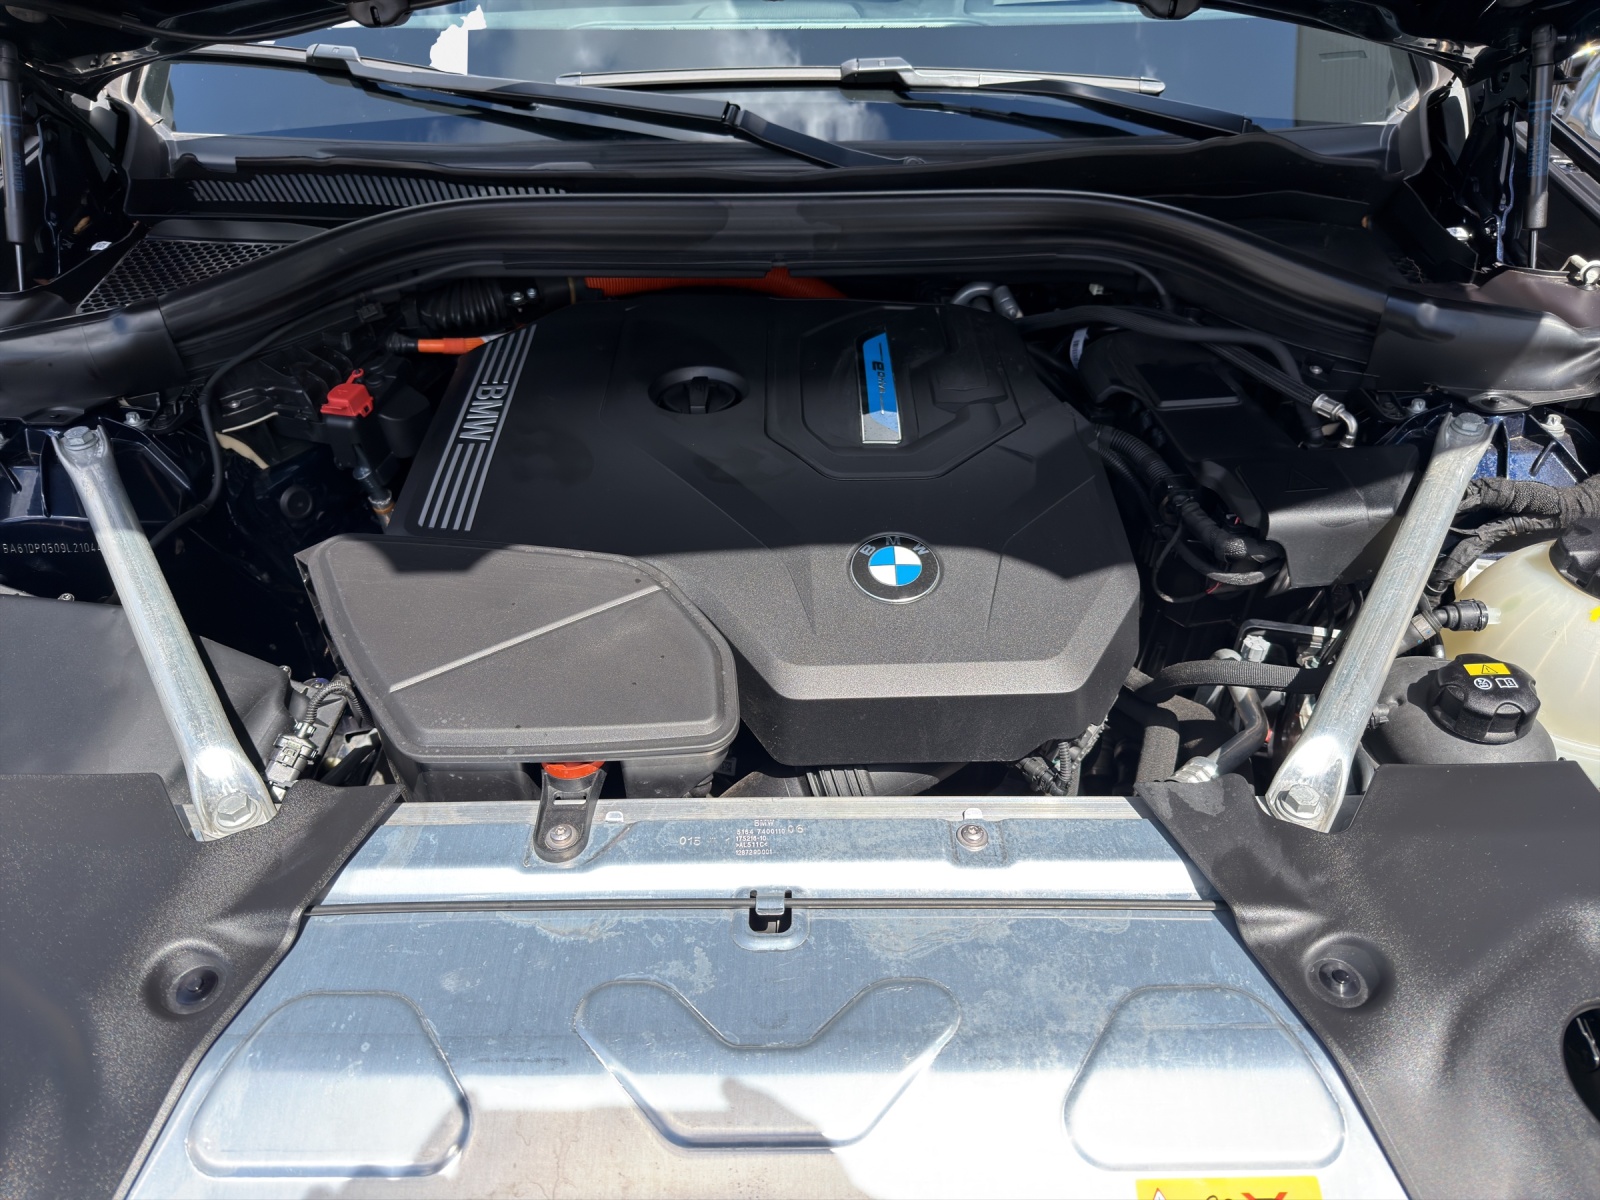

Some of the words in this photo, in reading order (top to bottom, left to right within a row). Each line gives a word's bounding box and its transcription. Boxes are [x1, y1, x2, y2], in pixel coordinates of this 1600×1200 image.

[459, 384, 509, 441] BMW
[859, 535, 930, 557] BMW
[754, 819, 775, 827] BMW
